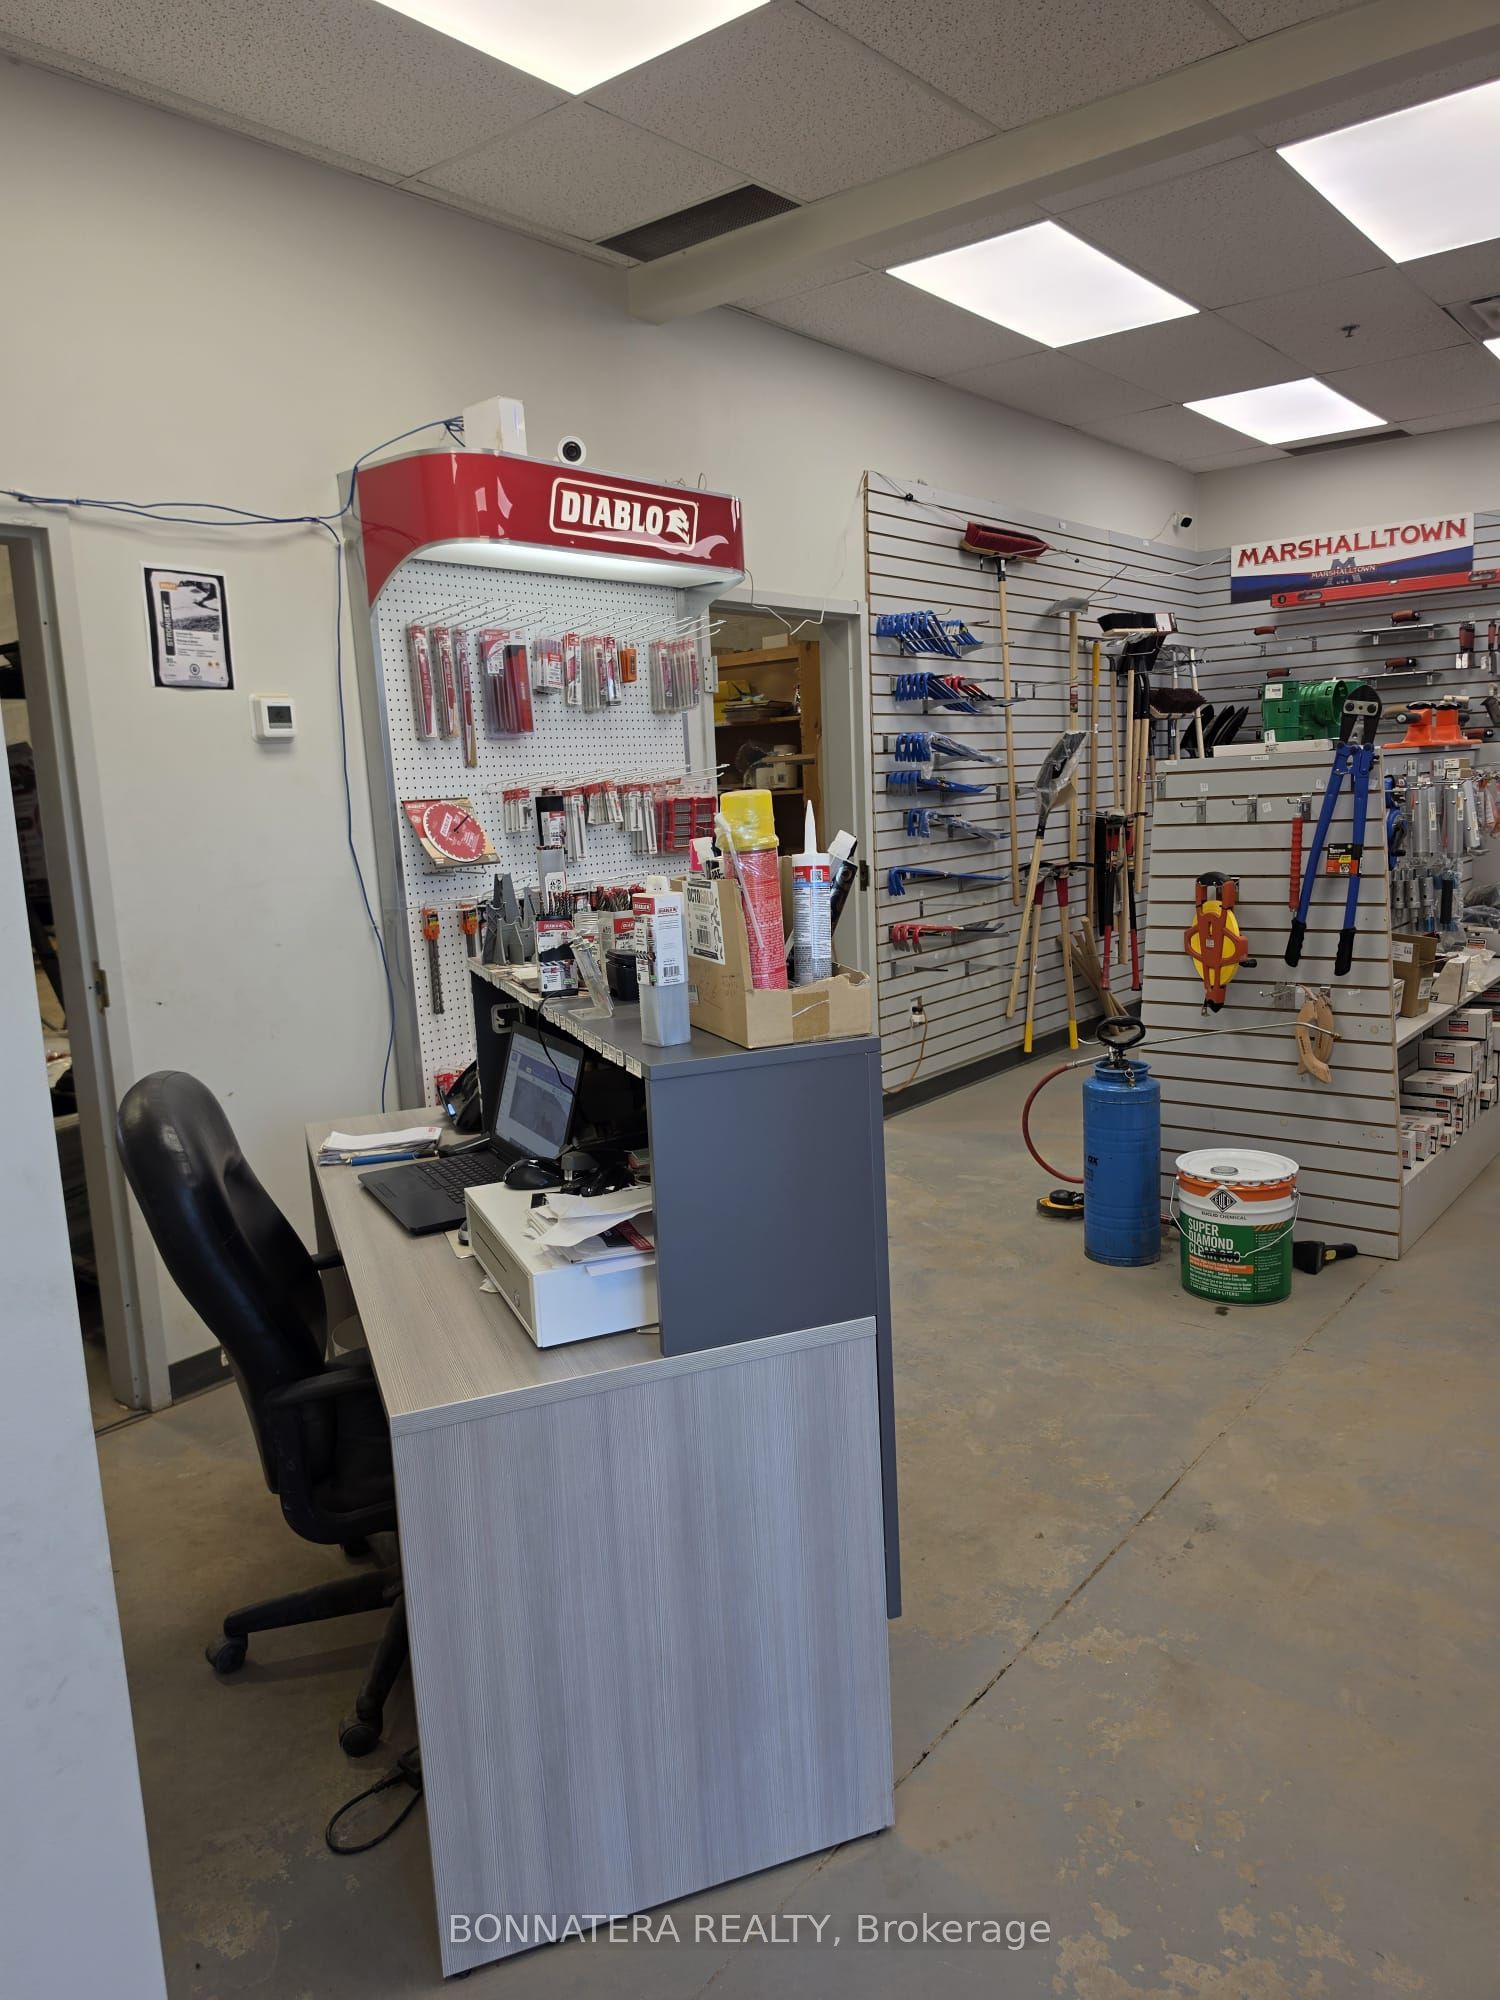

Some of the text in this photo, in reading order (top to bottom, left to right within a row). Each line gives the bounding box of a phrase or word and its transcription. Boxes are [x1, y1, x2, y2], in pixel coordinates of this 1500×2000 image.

[560, 489, 664, 536] DIABLO
[1237, 518, 1467, 567] MARSHALLTOWN
[1311, 564, 1377, 578] MARSHALLTOWN
[1188, 1218, 1219, 1237] SUPER
[1188, 1229, 1234, 1251] DIAMOND
